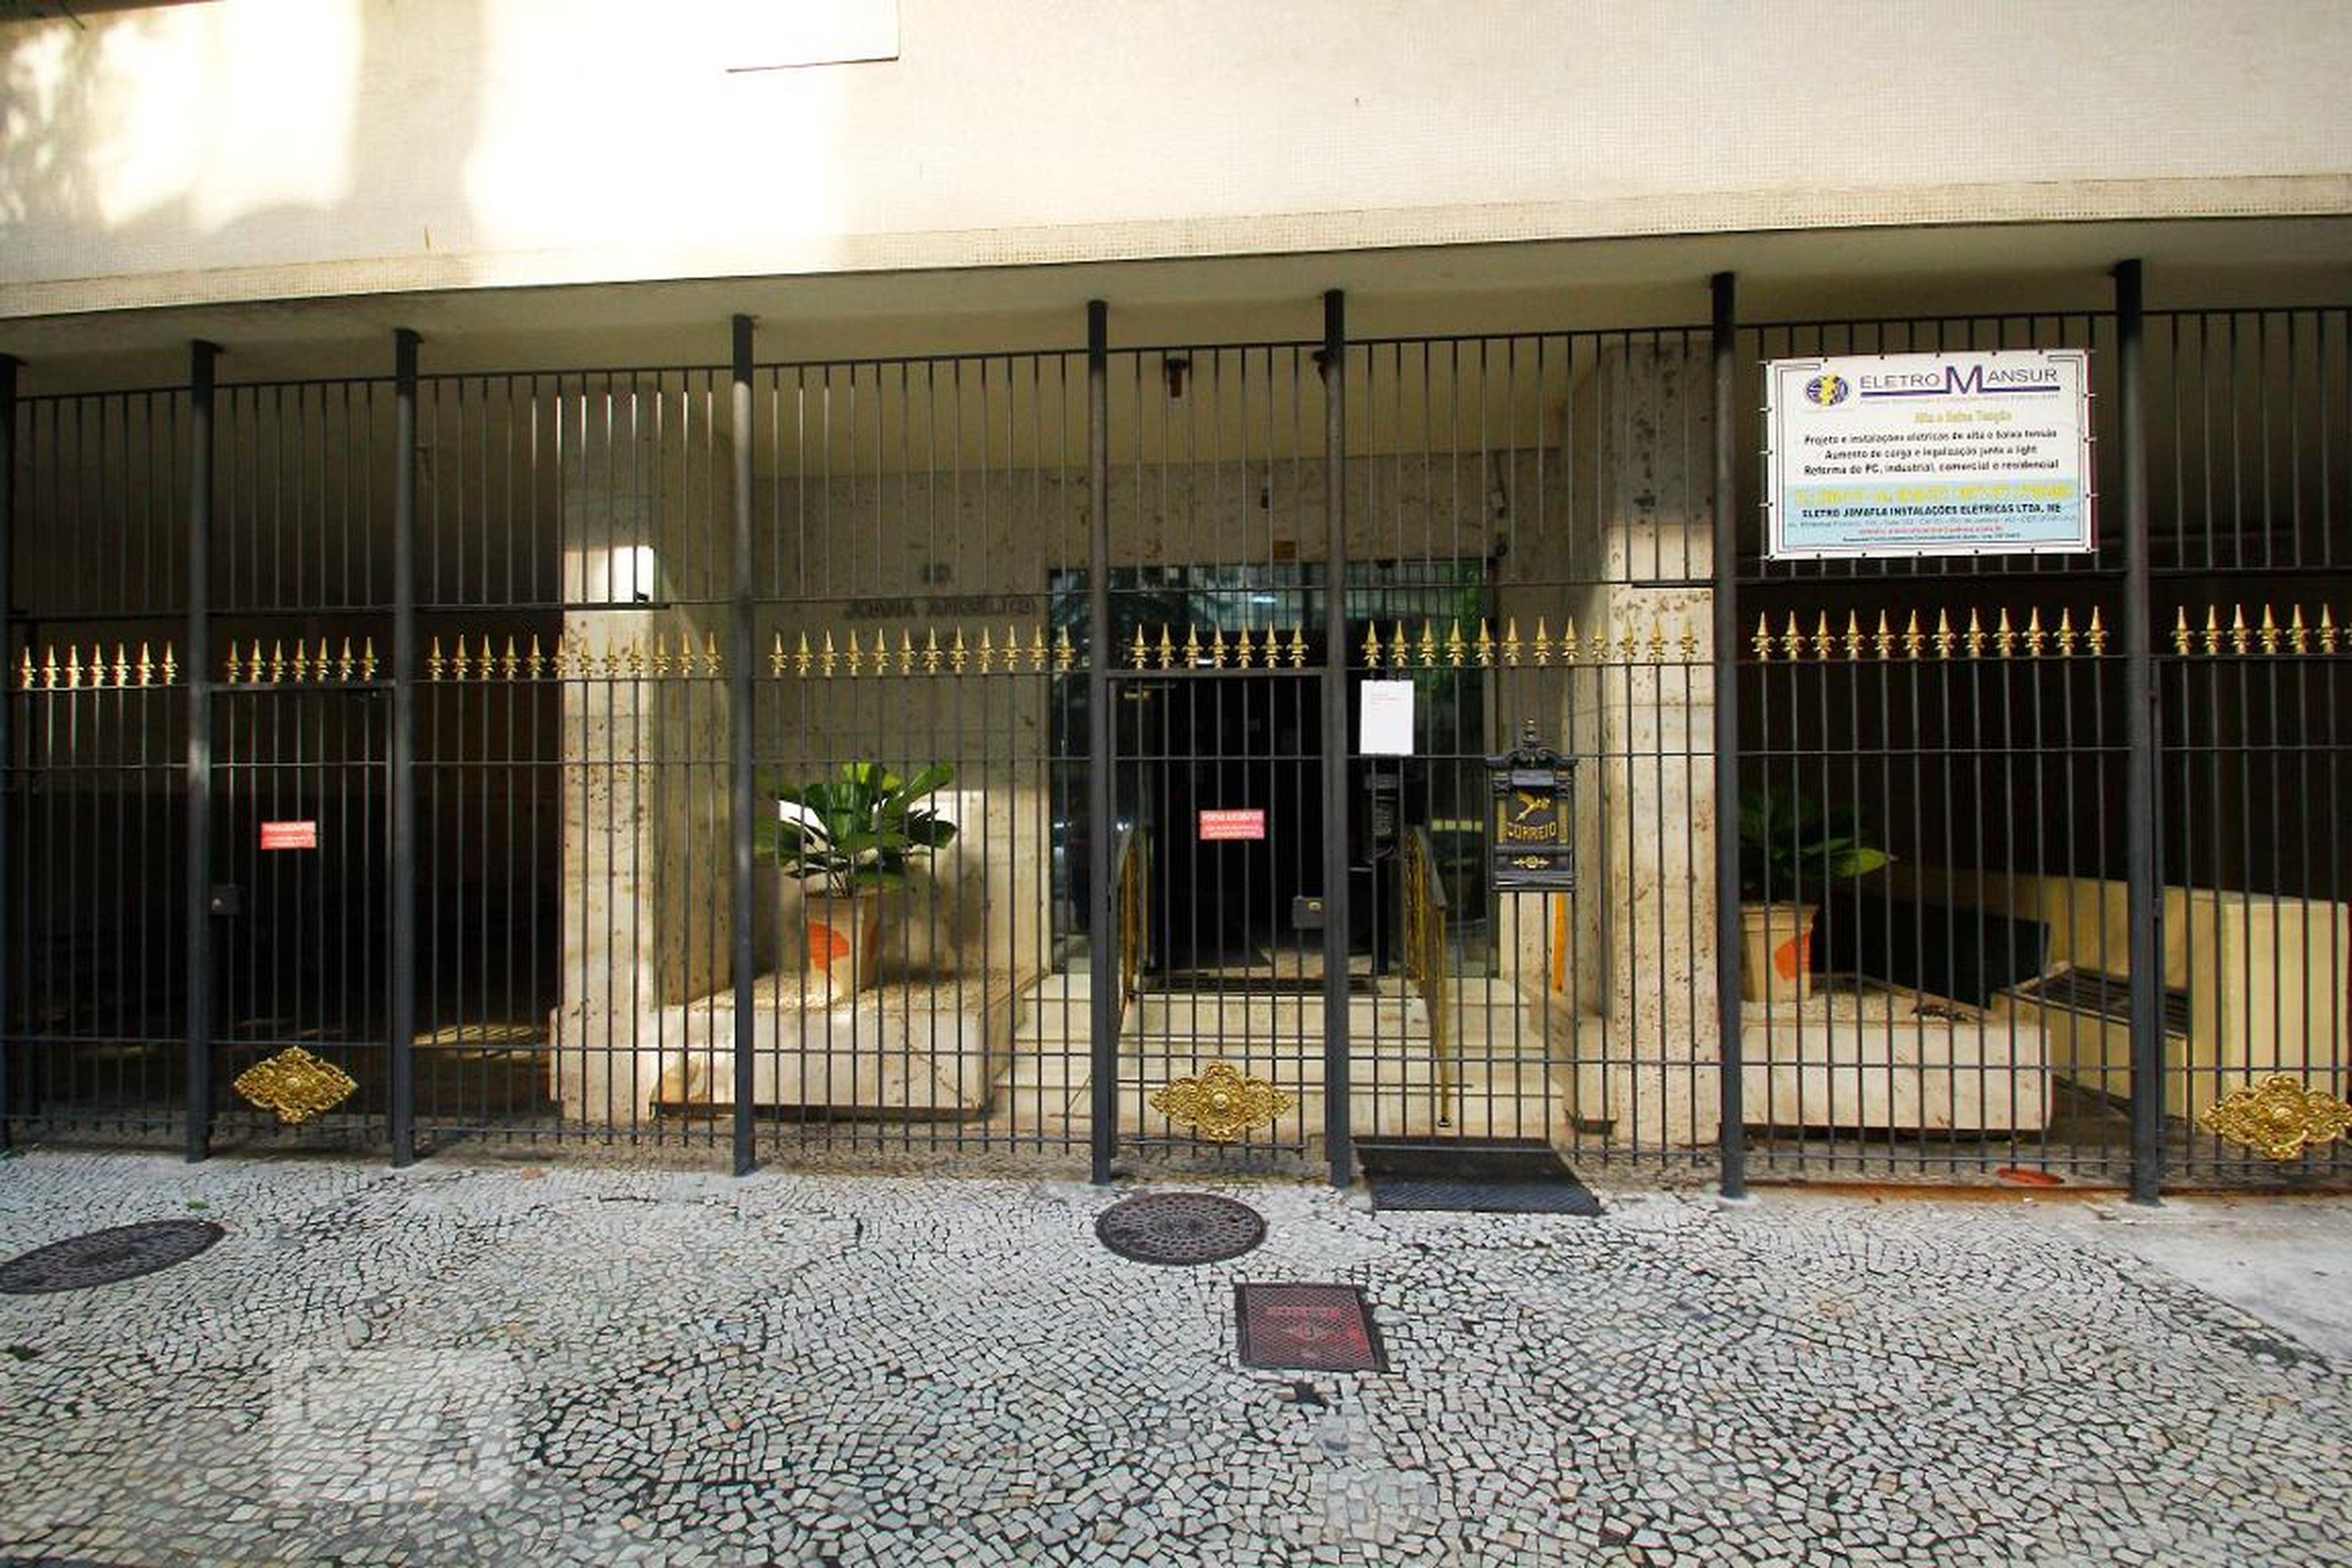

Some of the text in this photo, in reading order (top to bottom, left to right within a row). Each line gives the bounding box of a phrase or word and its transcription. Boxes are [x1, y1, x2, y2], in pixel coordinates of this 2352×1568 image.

[1804, 435, 1839, 447] Projeto
[1850, 432, 1904, 445] instalações
[1825, 450, 1868, 460] Aumento
[1871, 450, 1882, 458] de
[1885, 450, 1912, 460] carga
[1804, 465, 1847, 475] Reforma
[1939, 461, 1990, 472] comercial
[2002, 459, 2059, 470] residencial
[1801, 509, 1840, 518] ELETRO
[1890, 504, 1958, 516] INSTALAÇÕES
[1504, 821, 1556, 840] CORREIO
